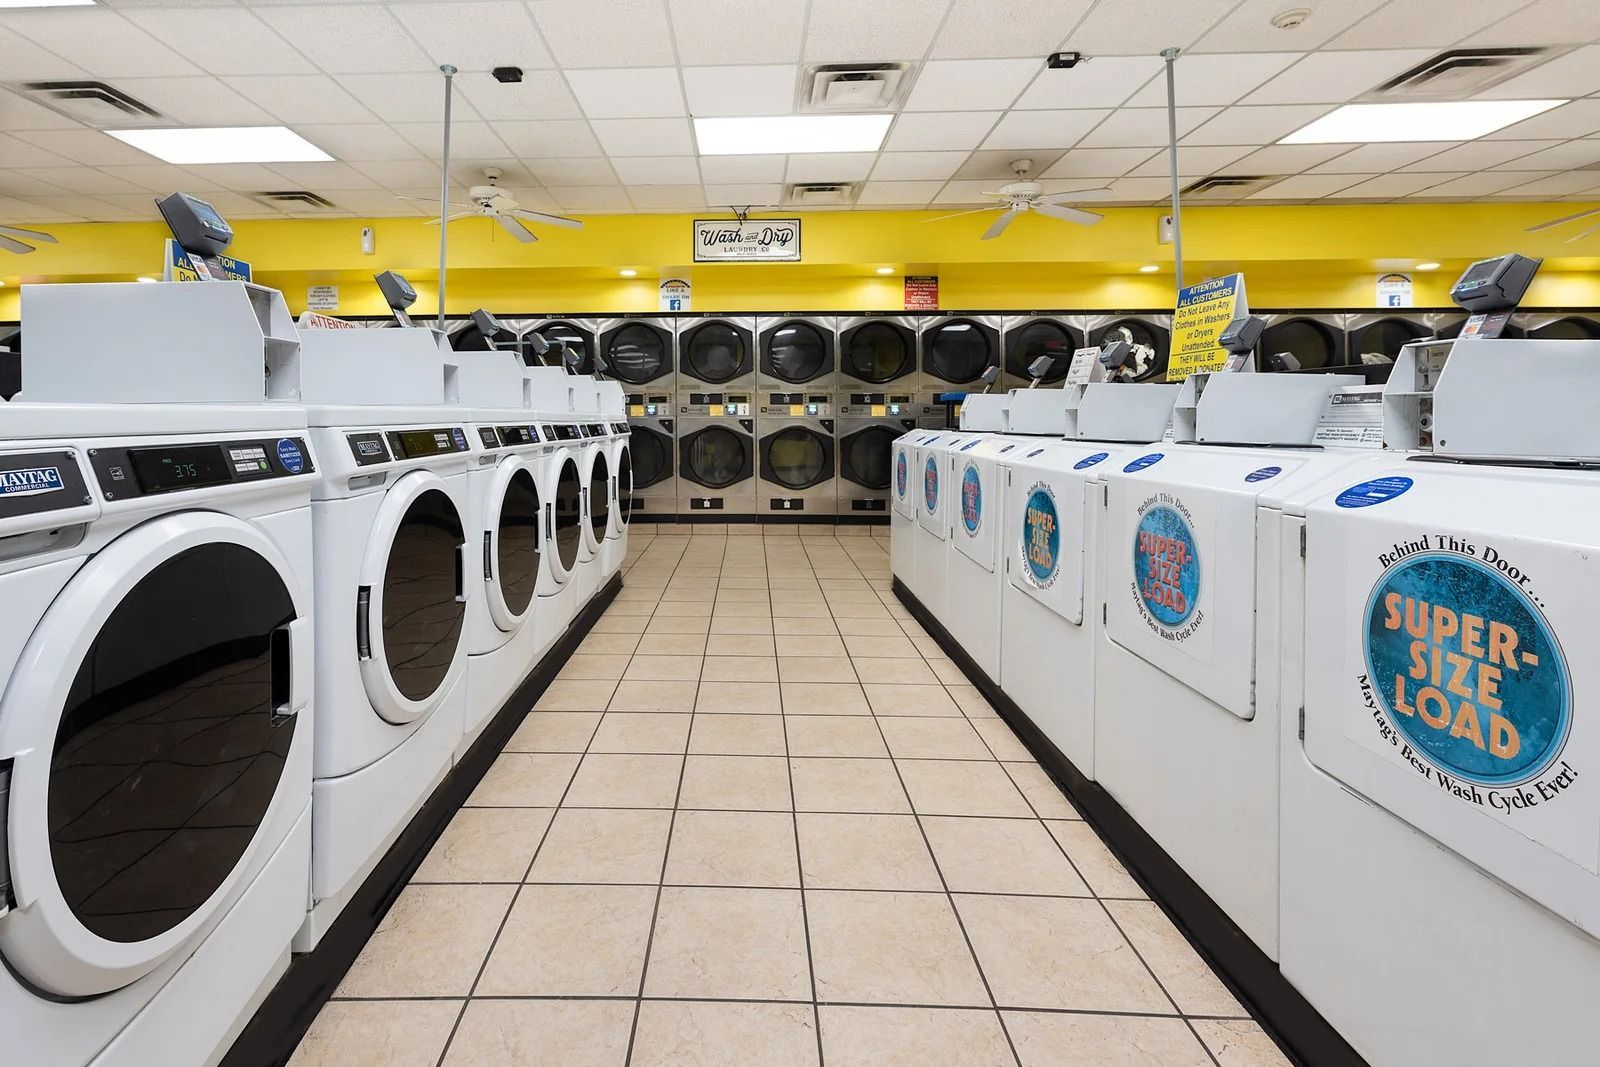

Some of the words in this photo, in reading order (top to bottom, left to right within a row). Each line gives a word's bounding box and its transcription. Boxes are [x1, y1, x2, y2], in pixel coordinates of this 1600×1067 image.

[700, 228, 744, 246] Wash
[745, 232, 759, 241] and
[758, 228, 794, 246] Dry
[1179, 299, 1191, 307] ALL
[1192, 287, 1232, 304] CUSTOMERS
[1189, 279, 1225, 295] ATTENTION
[1175, 319, 1196, 330] Clothes
[1205, 312, 1231, 324] Washers
[1178, 309, 1186, 318] Do
[1187, 307, 1198, 316] Not
[1199, 303, 1217, 314] Leave
[1218, 300, 1230, 310] Any
[1194, 328, 1214, 340] Dryers
[1180, 355, 1193, 364] THEY
[1194, 354, 1206, 362] WILL
[1207, 352, 1215, 360] BE
[1168, 366, 1193, 376] REMOVED
[5, 482, 50, 492] COMMERCIAL
[1137, 493, 1158, 516] Behind
[1160, 493, 1173, 503] This
[1028, 507, 1056, 532] SUPER-
[1032, 526, 1049, 551] SIZE
[1139, 530, 1192, 566] SUPER-
[1029, 543, 1051, 569] LOAD
[1378, 535, 1430, 569] Behind
[1435, 535, 1476, 555] This
[1149, 556, 1180, 589] SIZE
[1142, 578, 1187, 614] LOAD
[1131, 582, 1147, 619] Maytag's
[1147, 618, 1159, 635] Best
[1160, 628, 1175, 641] Wash
[1176, 629, 1191, 643] Cycle
[1191, 610, 1204, 633] Ever!
[1385, 592, 1539, 671] SUPER-
[1409, 640, 1503, 710] SIZE
[1393, 674, 1520, 759] LOAD
[1357, 673, 1399, 746] Maytag's
[1401, 745, 1431, 779] Best
[1436, 772, 1483, 806] Wash
[1488, 789, 1538, 815] Cycle
[1534, 761, 1578, 802] Ever!
